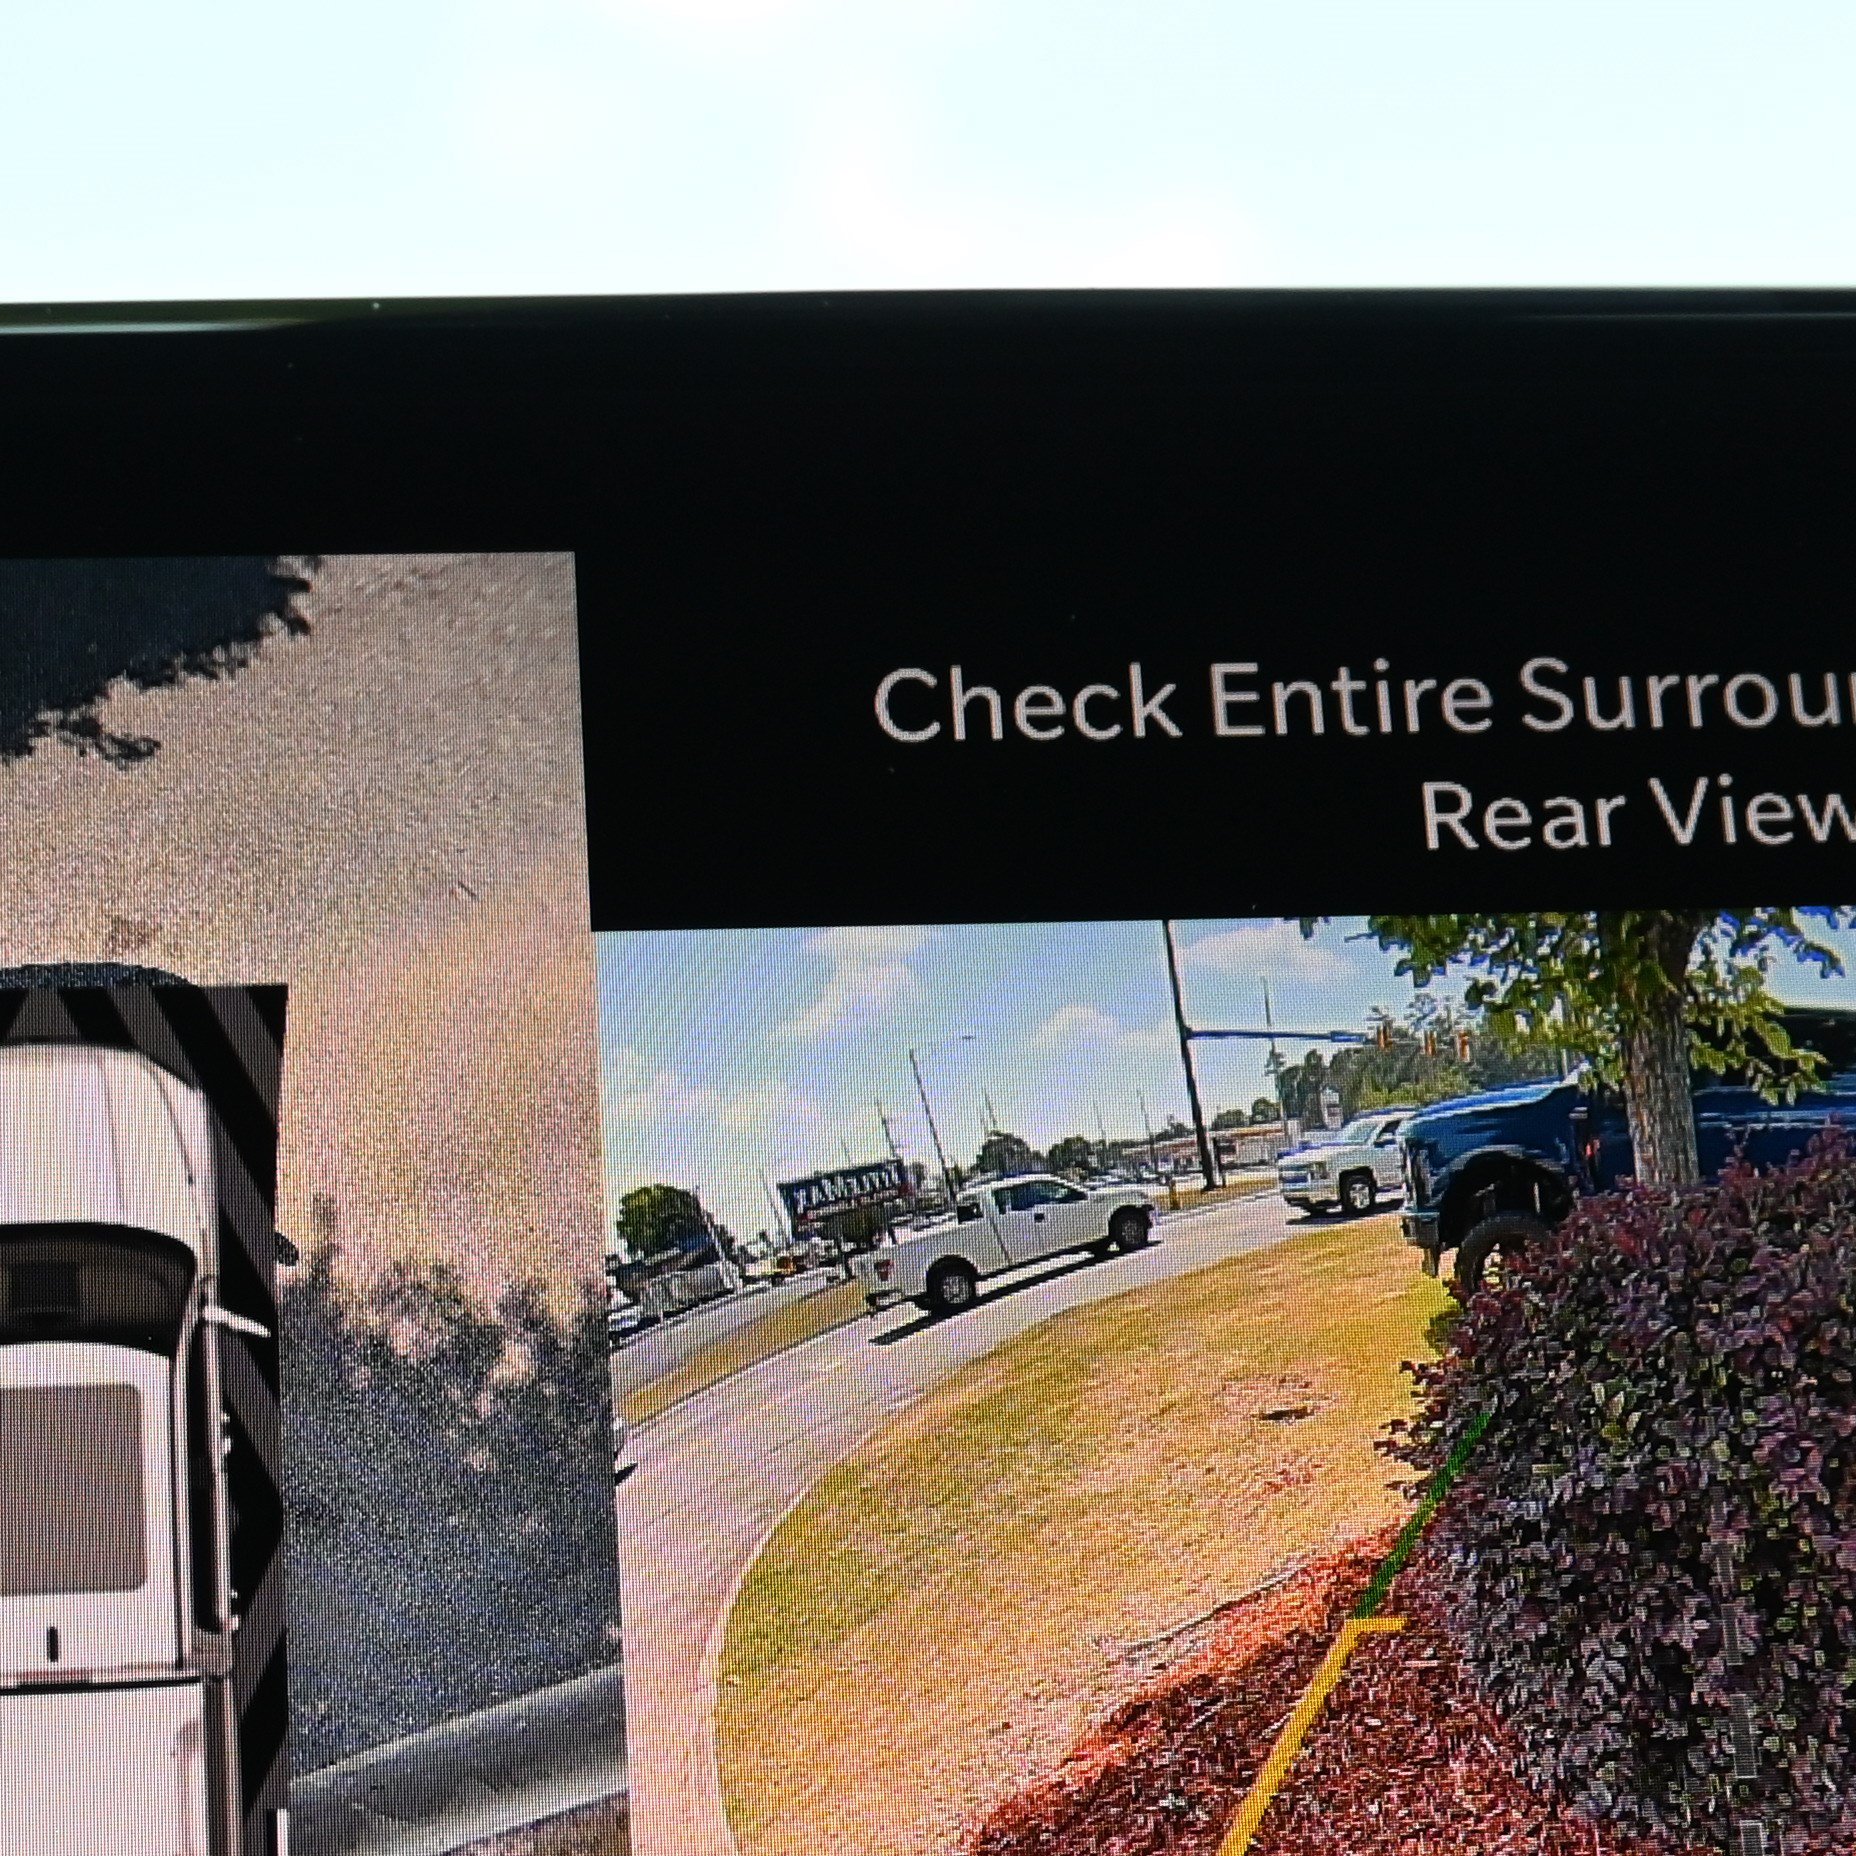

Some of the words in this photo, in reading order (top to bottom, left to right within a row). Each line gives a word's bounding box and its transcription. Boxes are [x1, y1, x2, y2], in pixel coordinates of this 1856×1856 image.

[873, 661, 1183, 743] Check
[1209, 656, 1494, 737] Entire
[1421, 780, 1627, 852] Rear
